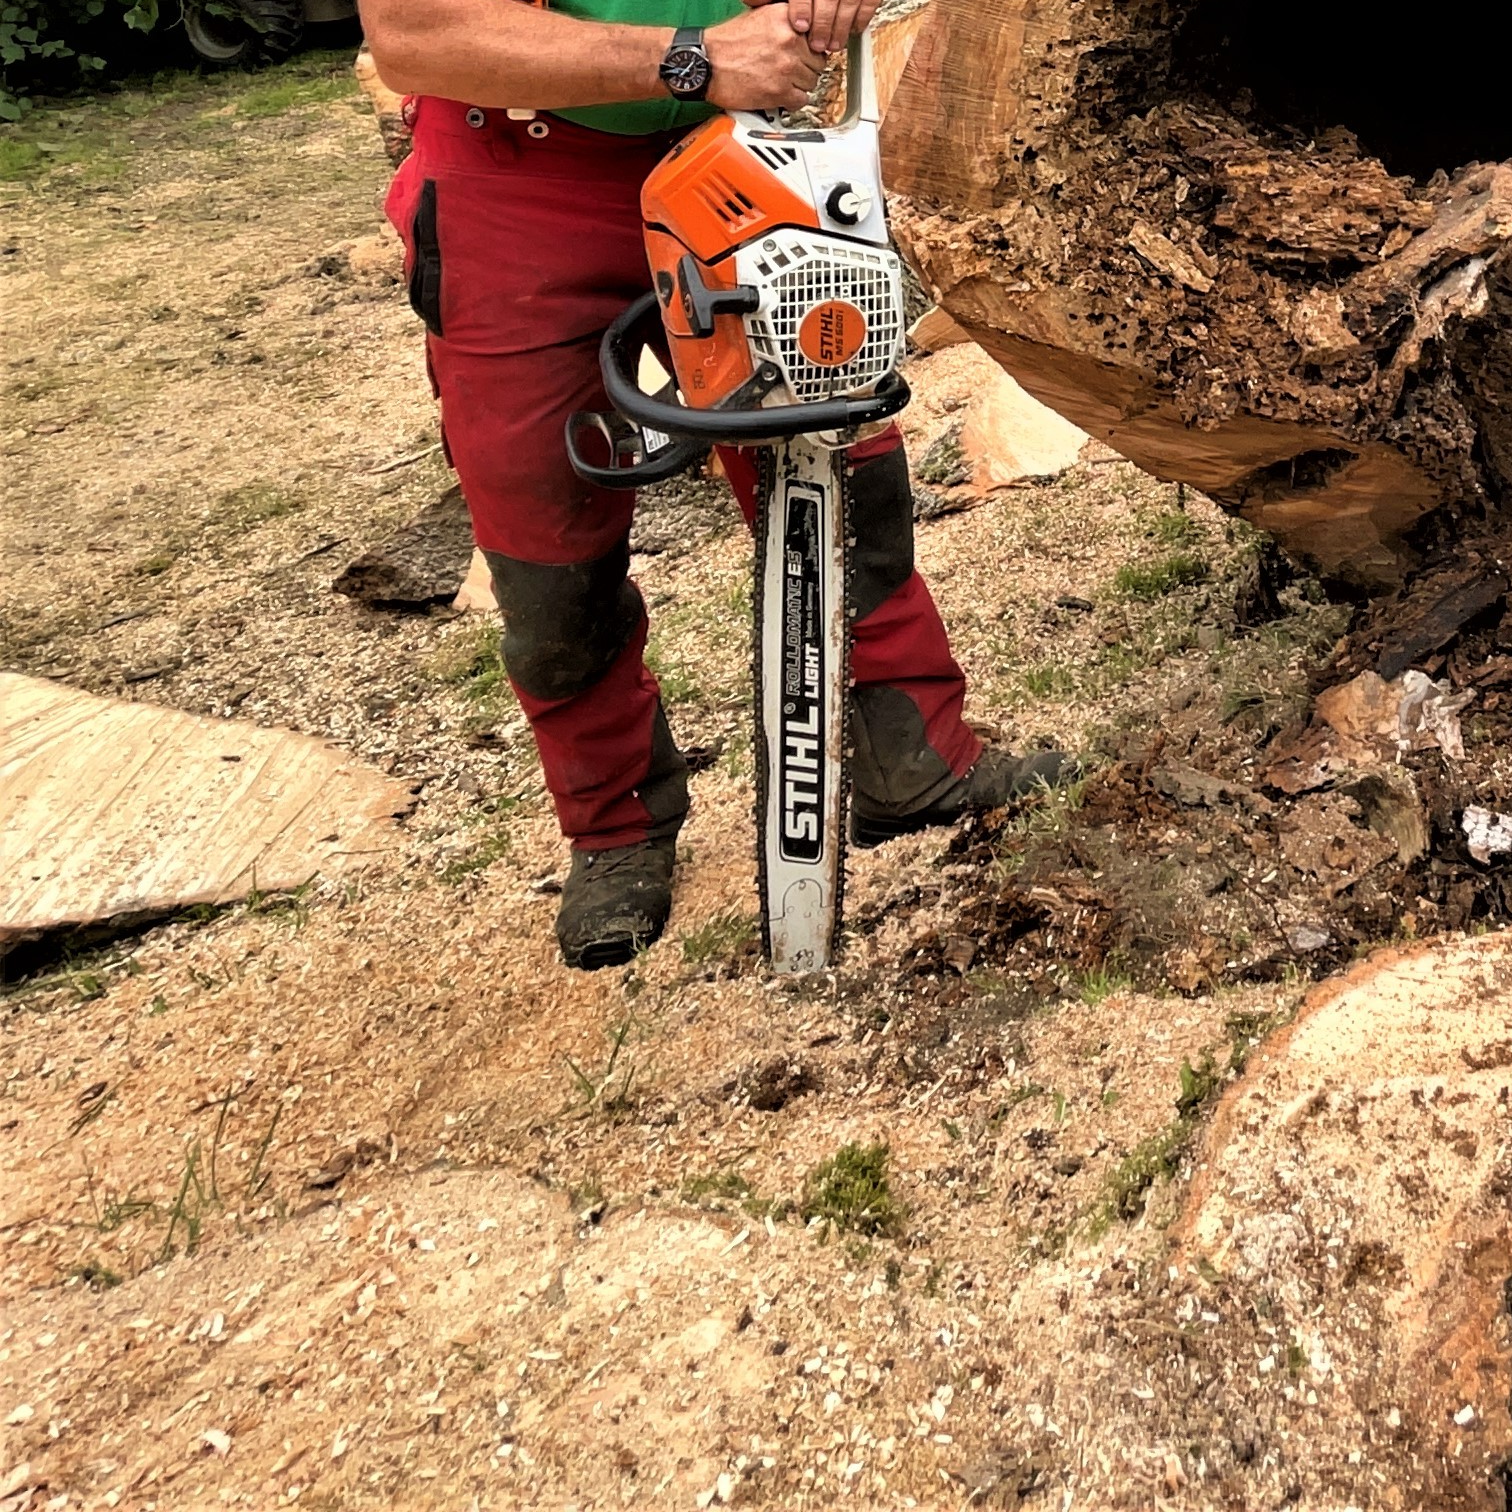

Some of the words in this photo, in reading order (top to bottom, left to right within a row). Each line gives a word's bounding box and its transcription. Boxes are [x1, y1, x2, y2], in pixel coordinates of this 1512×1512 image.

[820, 307, 833, 361] STIHL
[786, 550, 802, 577] ES
[787, 577, 802, 696] ROLLOMATIC
[804, 643, 820, 700] LIGHT
[785, 705, 819, 842] STIHL
